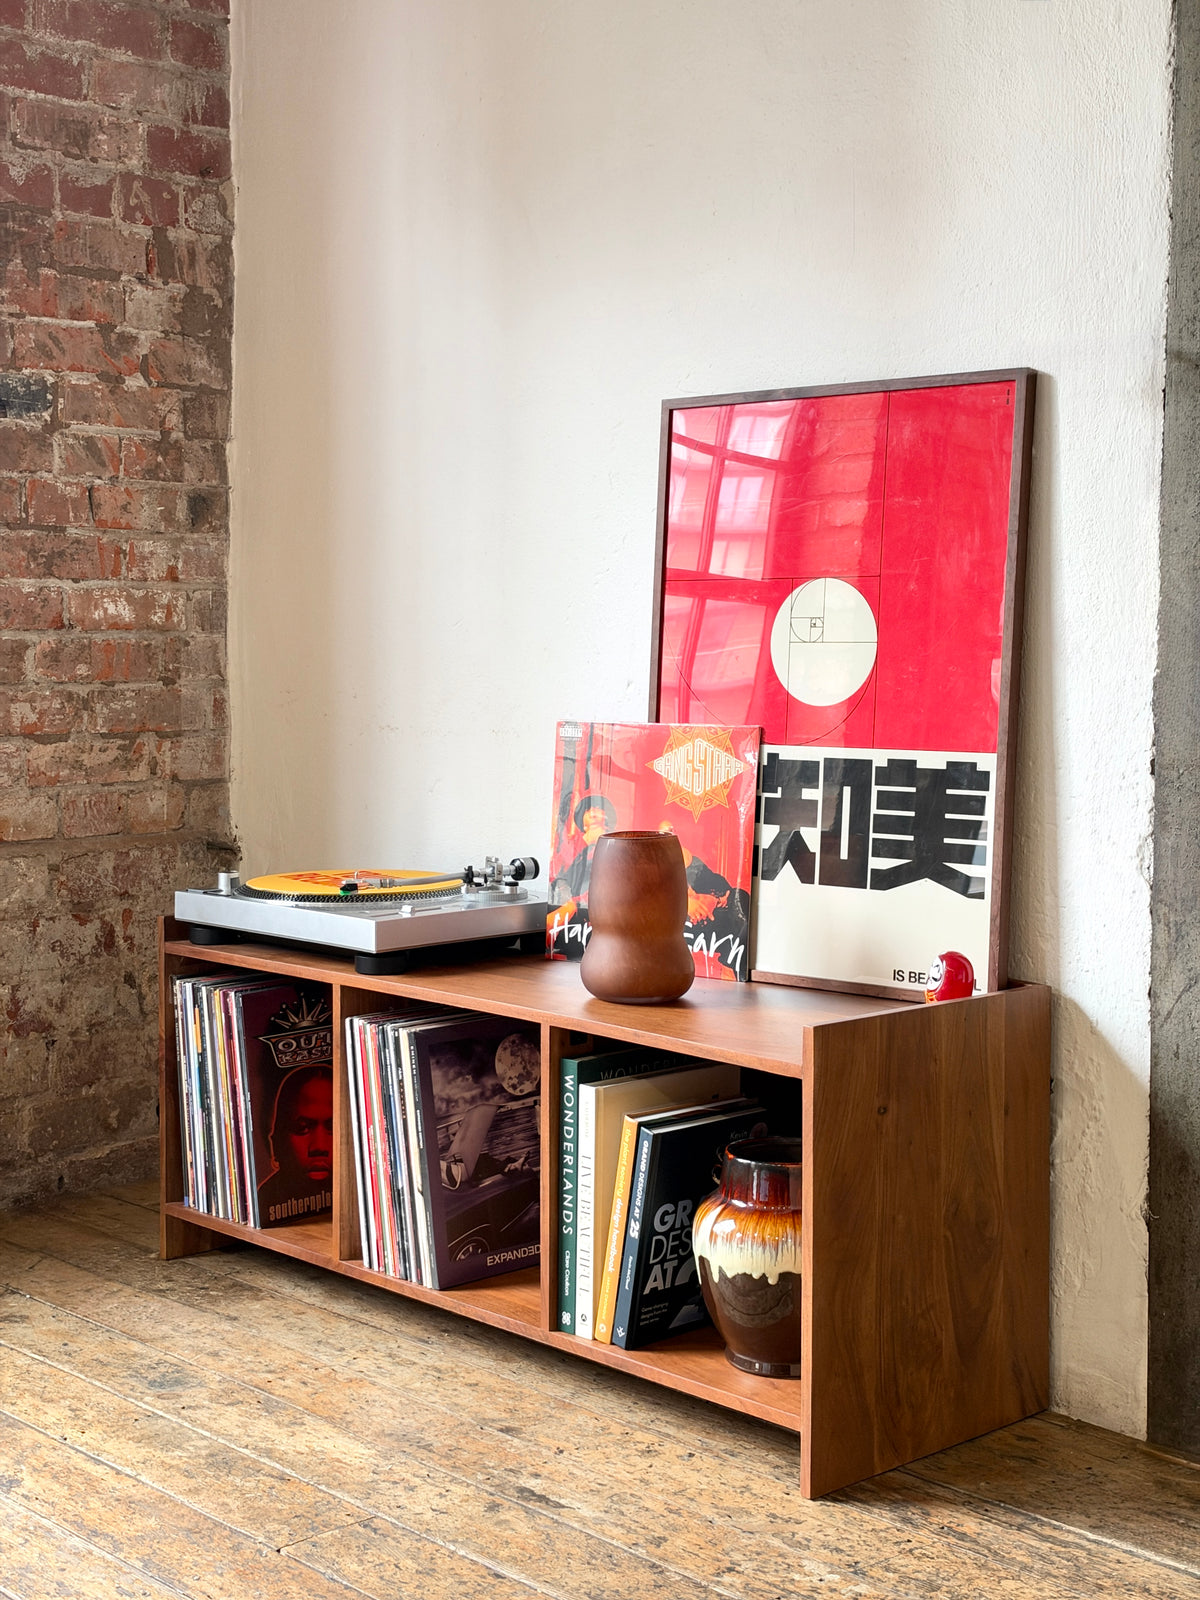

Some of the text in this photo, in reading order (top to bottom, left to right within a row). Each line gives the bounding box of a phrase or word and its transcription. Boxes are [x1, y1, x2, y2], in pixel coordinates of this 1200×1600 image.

[549, 912, 593, 947] Har
[892, 968, 905, 982] IS
[563, 1075, 575, 1235] WONDERLANDS
[622, 1141, 630, 1165] plant
[641, 1140, 649, 1171] GRAND
[617, 1165, 627, 1197] society
[636, 1172, 645, 1206] DESIGNS
[269, 1191, 333, 1221] southernpla
[613, 1198, 623, 1227] design
[633, 1206, 640, 1218] AT
[629, 1218, 640, 1239] 25
[486, 1244, 541, 1266] EXPANDED
[608, 1228, 620, 1273] handbook
[642, 1259, 678, 1295] AT
